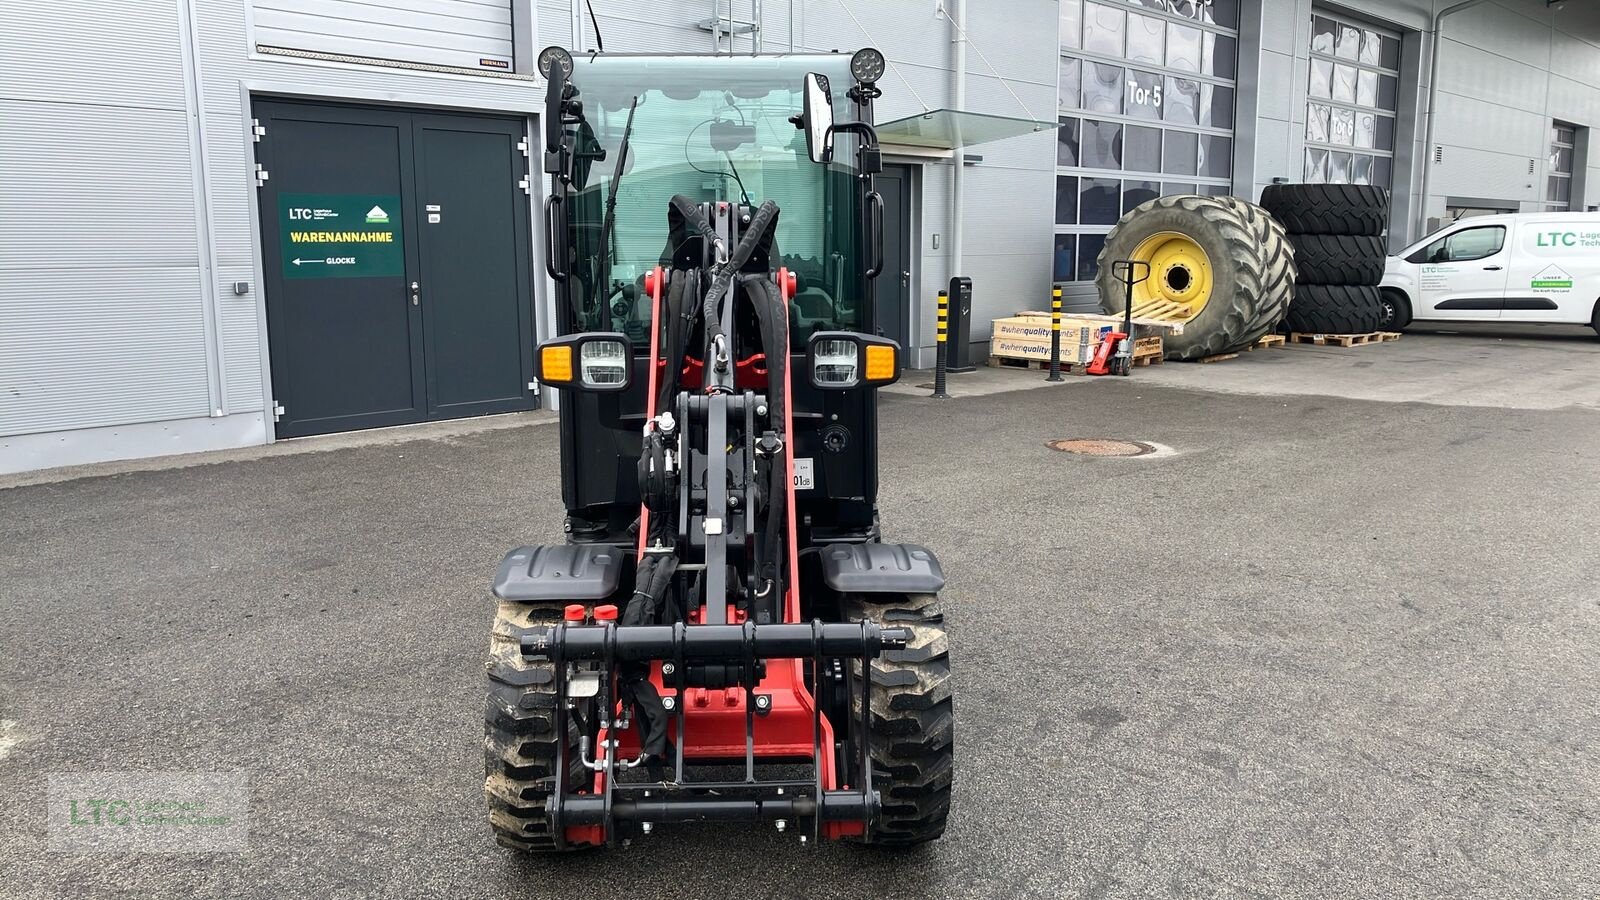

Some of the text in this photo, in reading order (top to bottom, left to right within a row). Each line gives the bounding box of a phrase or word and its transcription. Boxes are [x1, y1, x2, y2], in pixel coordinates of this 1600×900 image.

[1127, 80, 1161, 107] Tor 5
[1332, 116, 1354, 136] Tor 6
[289, 208, 313, 220] LTC
[290, 231, 393, 243] WARENANNAHME
[1537, 232, 1577, 247] LTC
[325, 257, 356, 265] GLOCKE
